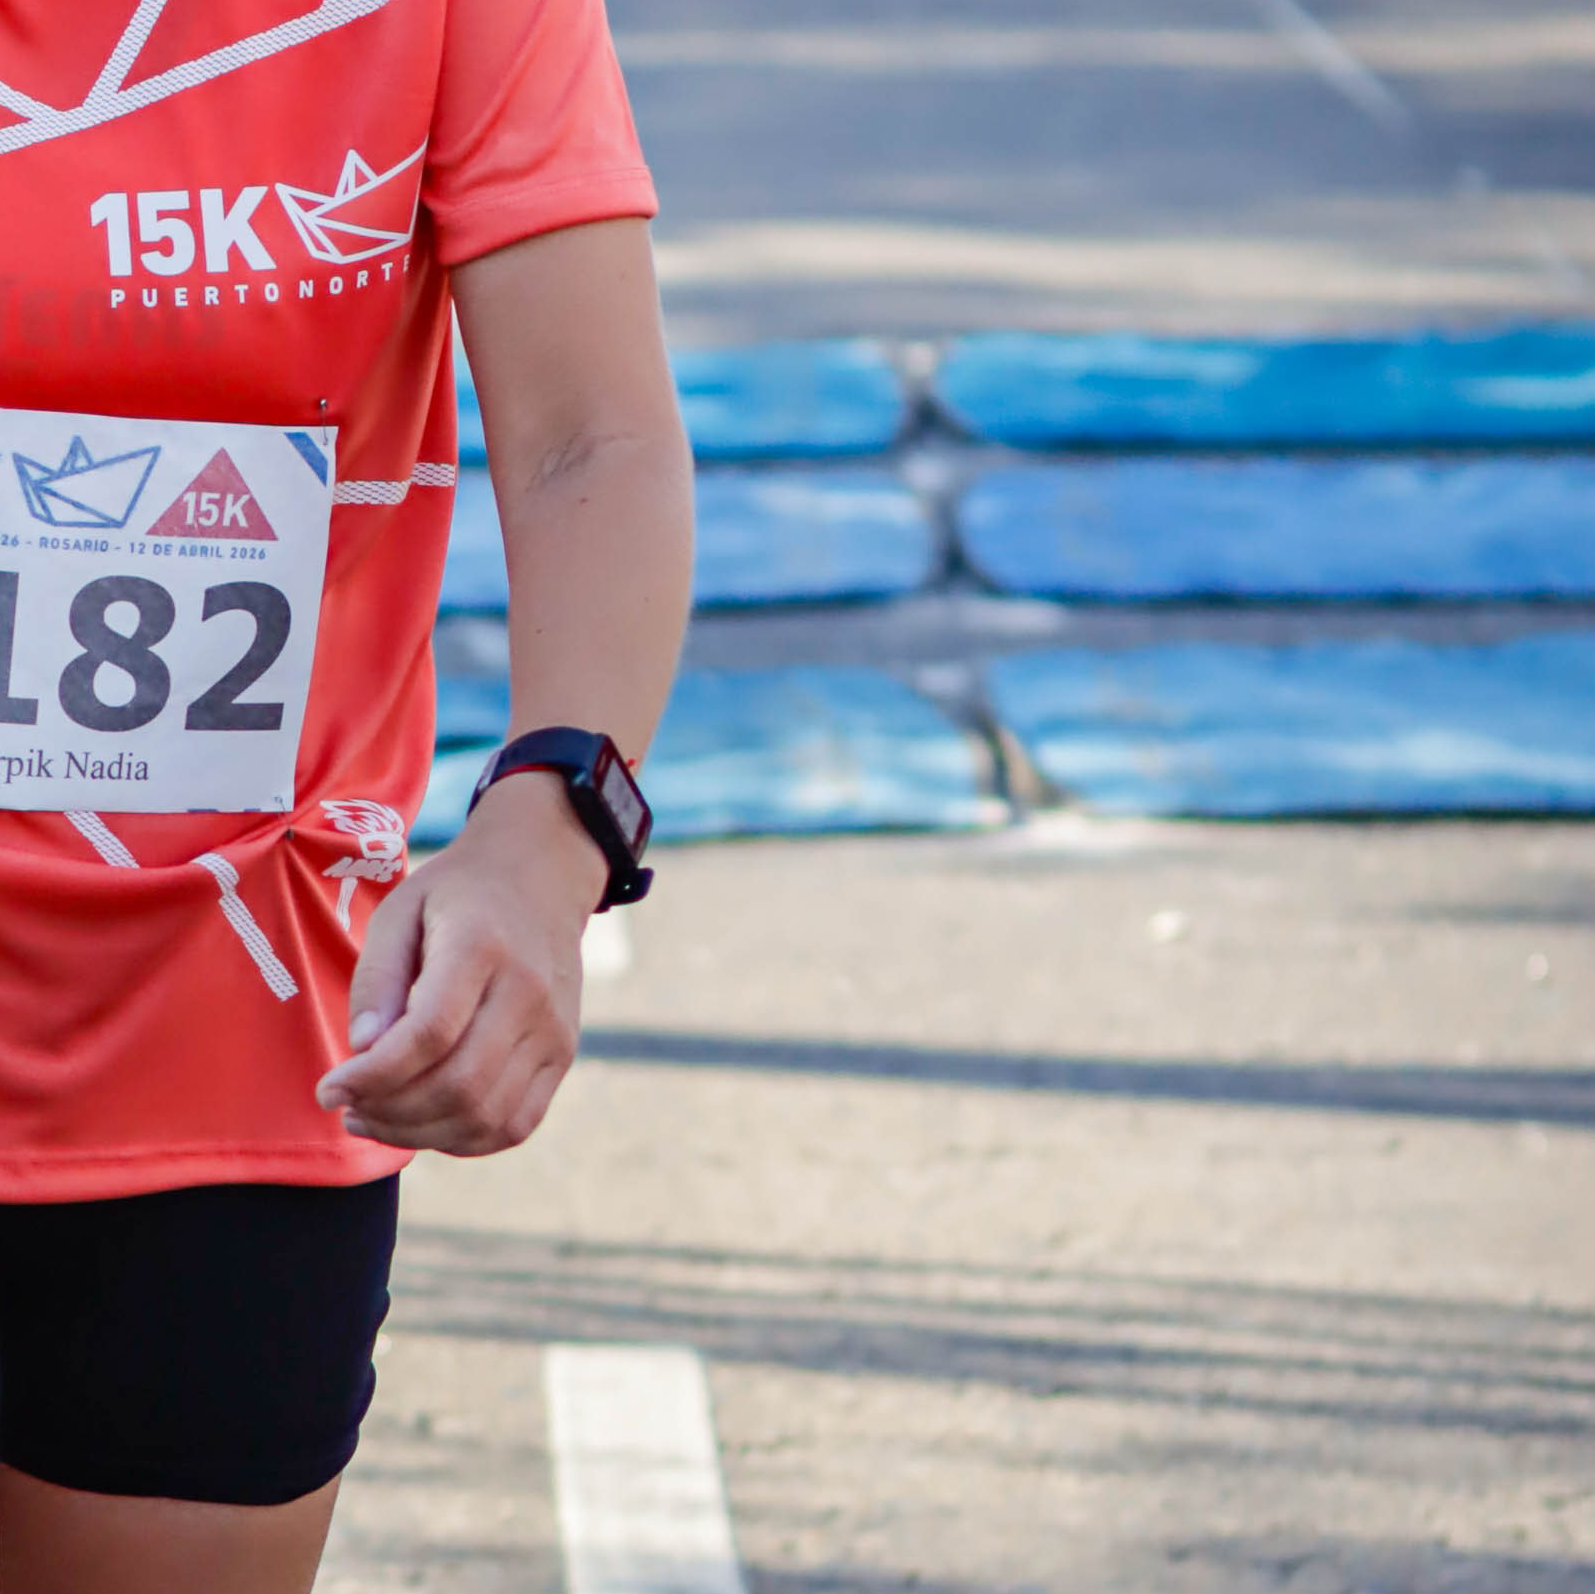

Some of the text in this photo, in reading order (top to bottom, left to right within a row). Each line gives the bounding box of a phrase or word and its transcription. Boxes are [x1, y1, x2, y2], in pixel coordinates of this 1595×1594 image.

[90, 185, 277, 276] 15K
[111, 282, 279, 308] PUERTO
[181, 490, 250, 529] 15K
[39, 536, 109, 553] ROSARIO
[129, 542, 146, 555] 12
[152, 543, 172, 556] DE
[178, 544, 223, 558] ABRIL
[230, 546, 267, 560] 2026
[64, 751, 149, 781] Nadia
